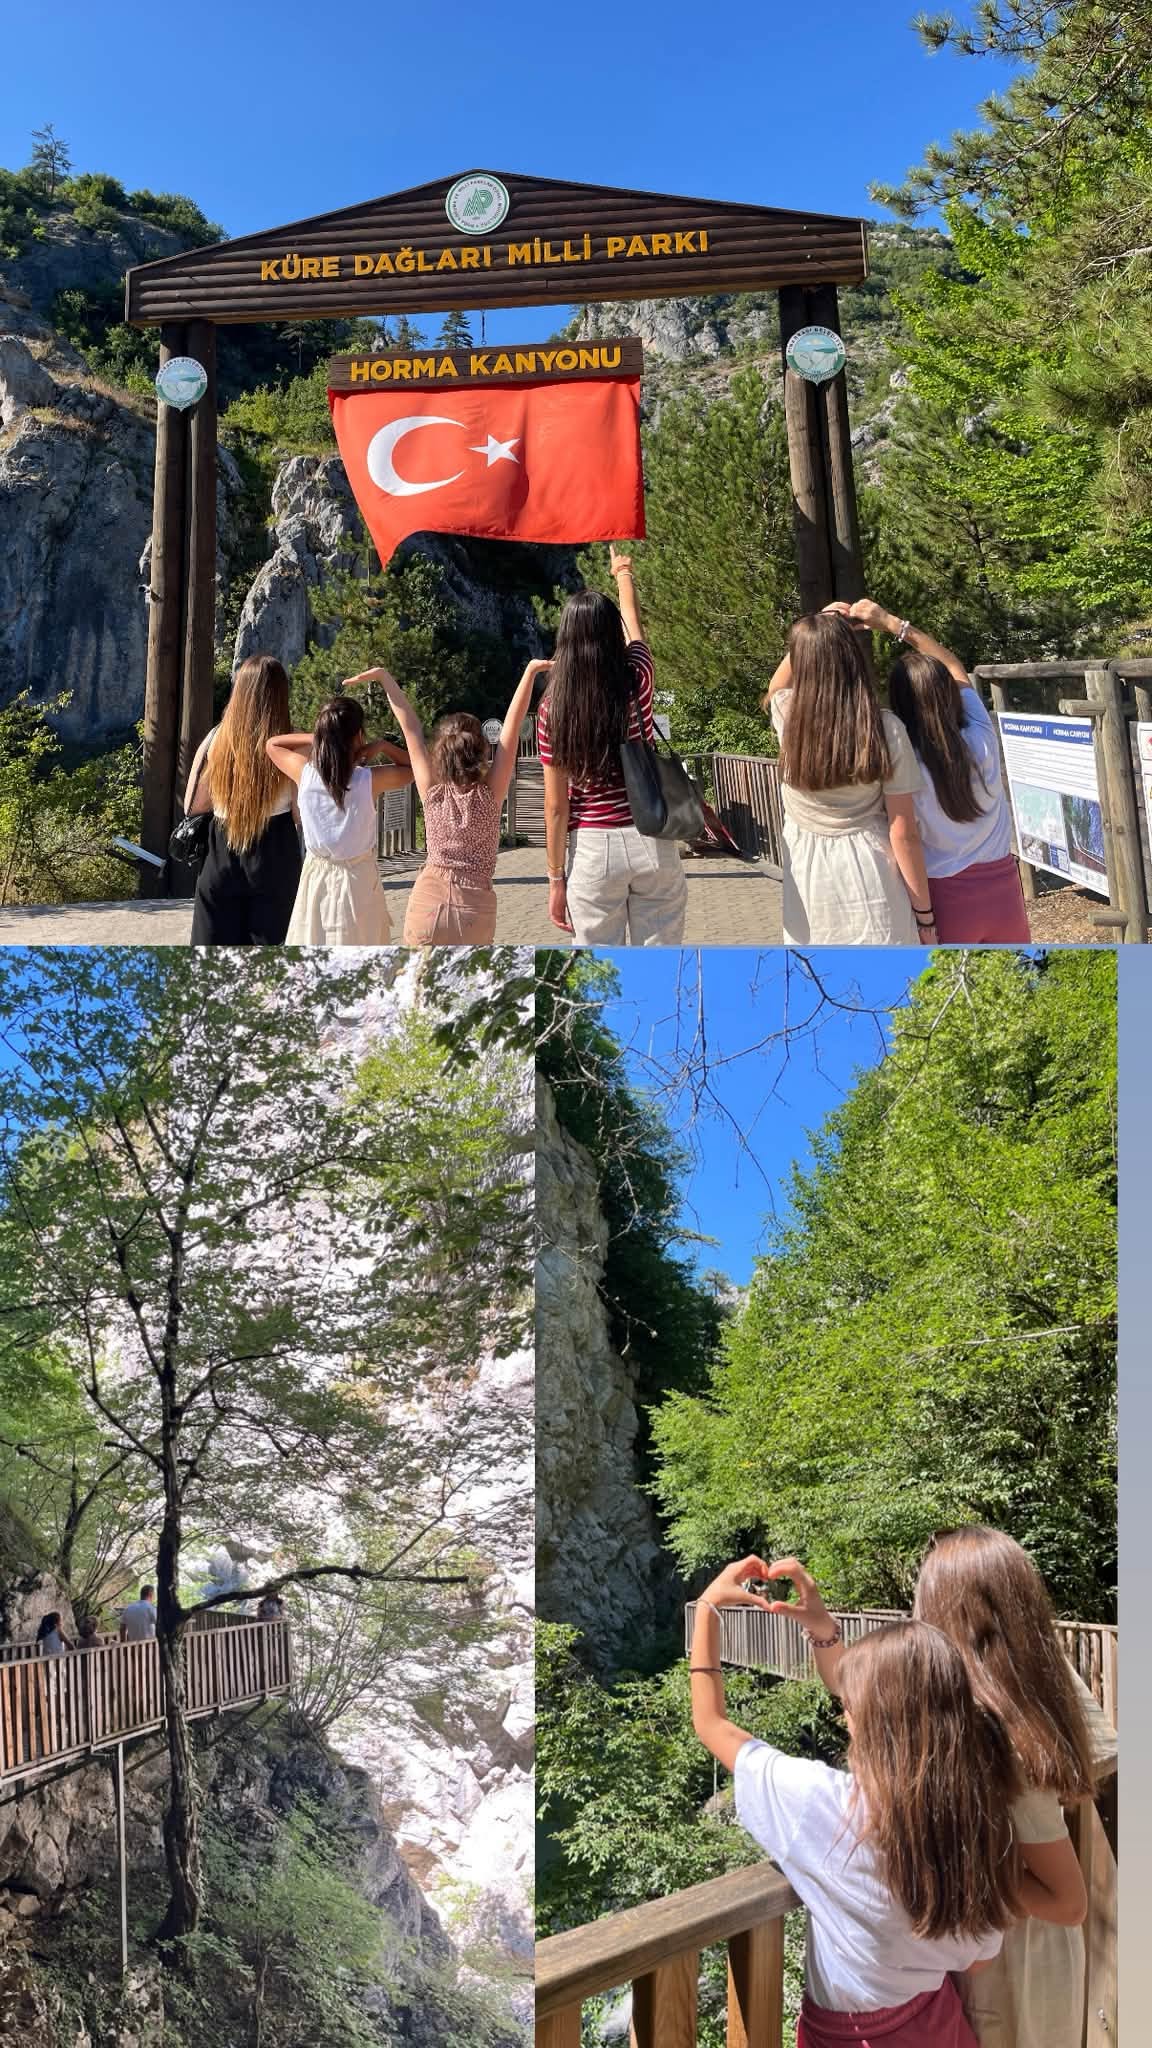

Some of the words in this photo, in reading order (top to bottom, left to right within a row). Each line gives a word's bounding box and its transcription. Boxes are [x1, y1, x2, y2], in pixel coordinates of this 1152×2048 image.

[261, 253, 341, 281] KÜRE
[354, 246, 493, 276] DAĞLARI
[508, 233, 591, 265] MİLLİ
[607, 230, 709, 259] PARKI
[351, 356, 459, 381] HORMA
[470, 345, 622, 376] KANYONU
